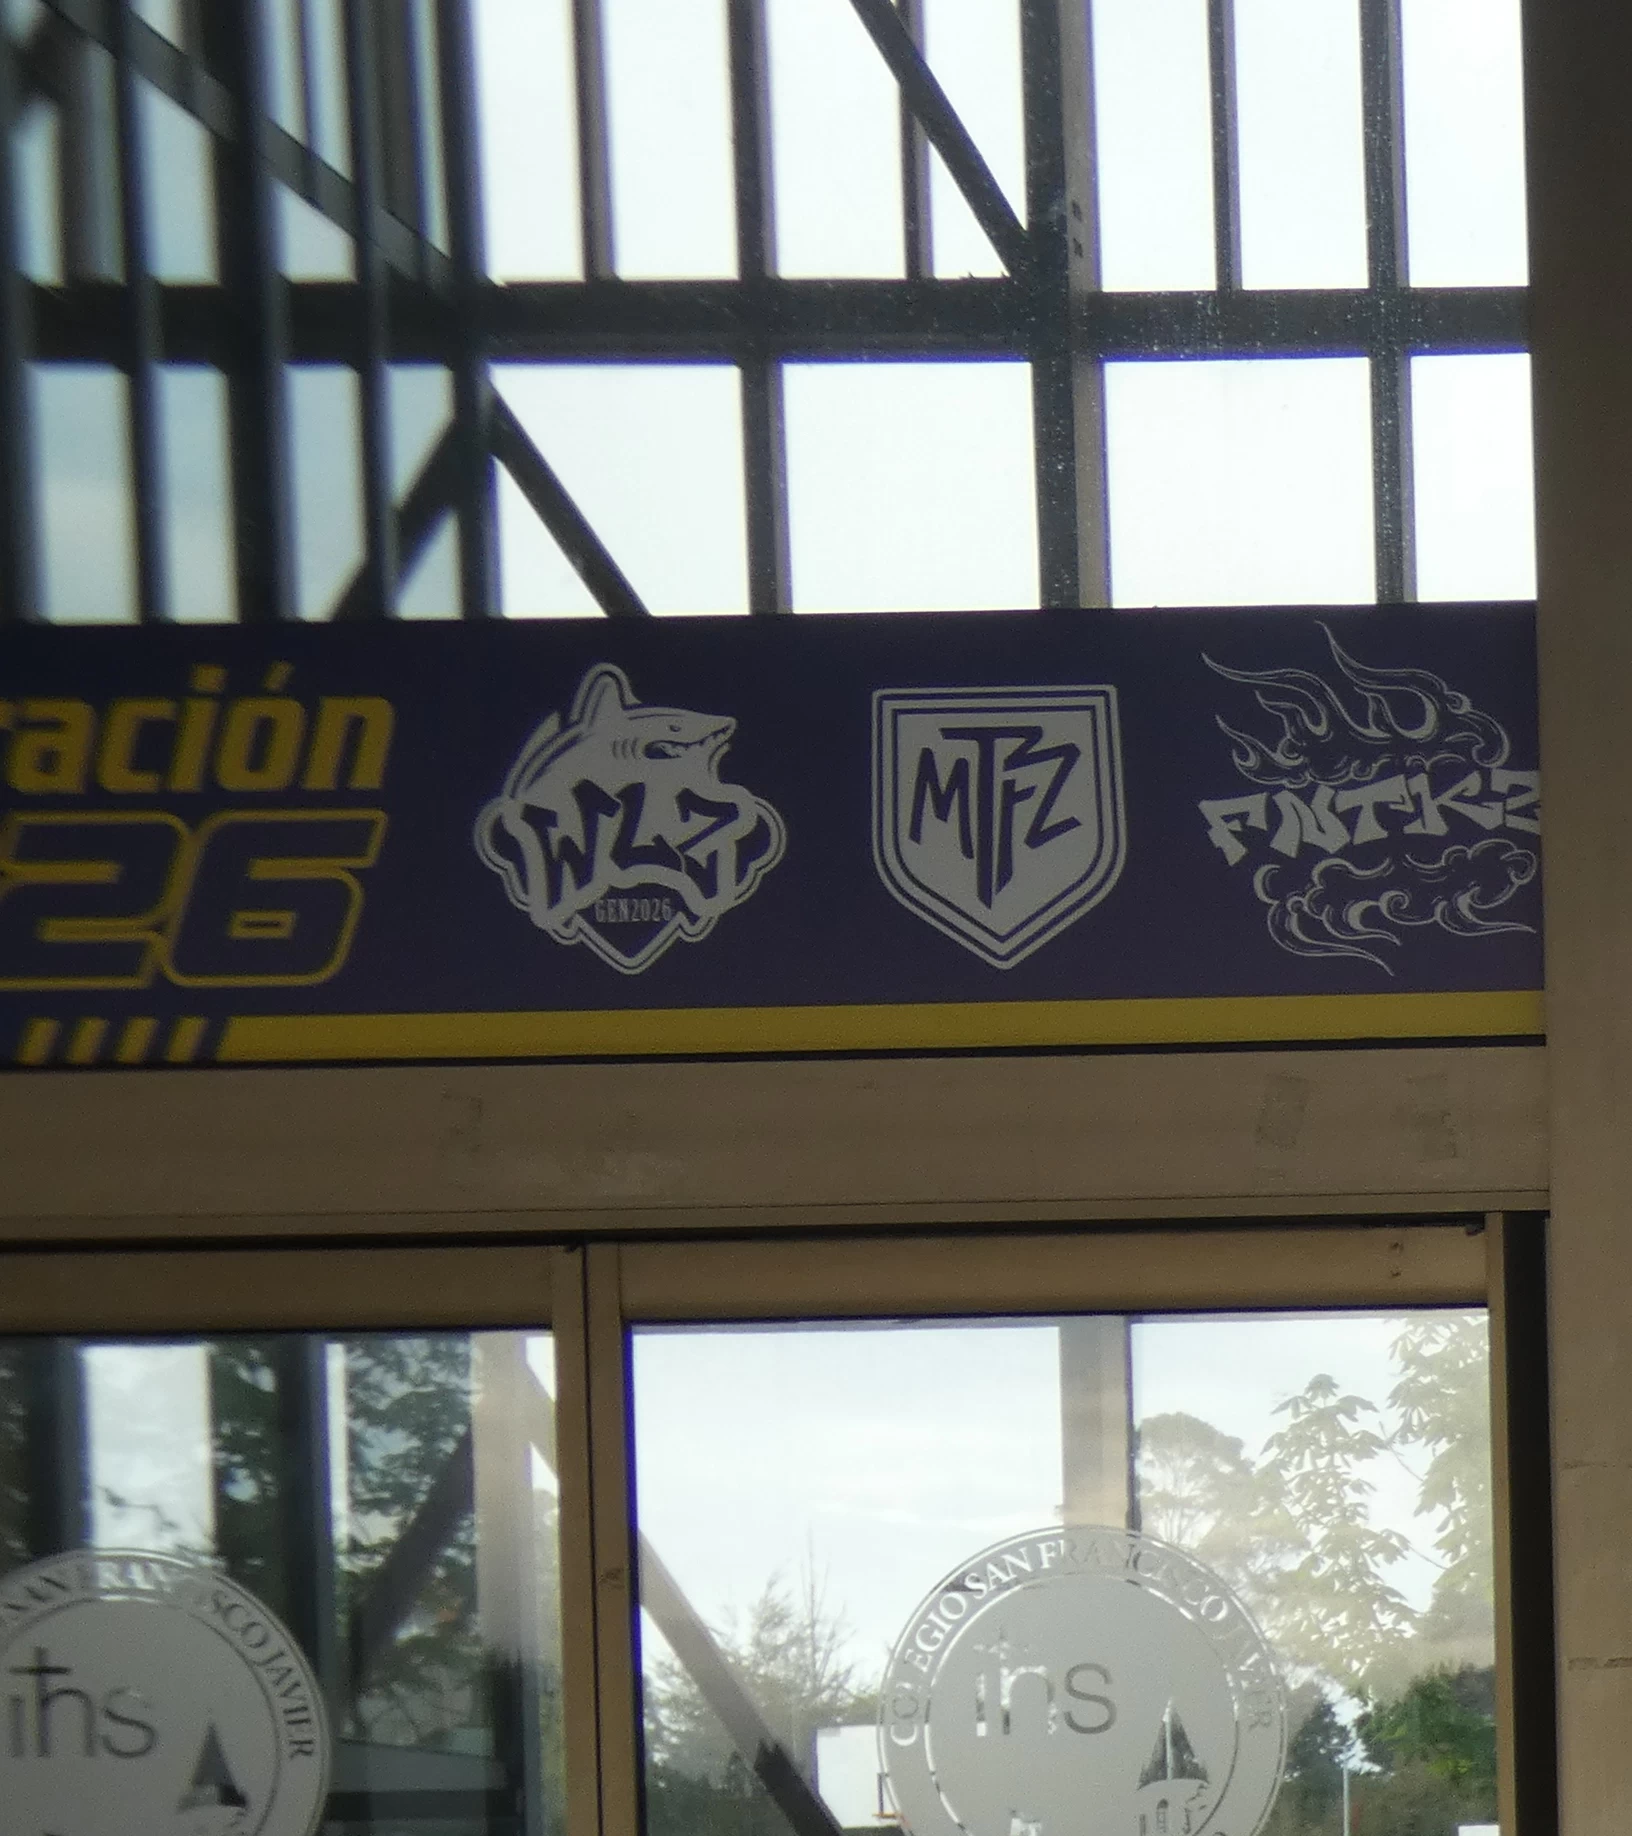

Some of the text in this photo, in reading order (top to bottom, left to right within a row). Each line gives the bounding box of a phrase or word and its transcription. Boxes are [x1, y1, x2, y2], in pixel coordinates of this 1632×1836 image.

[0, 662, 396, 794] ación
[965, 1547, 1031, 1600] SAN
[252, 1646, 315, 1759] JAVIER
